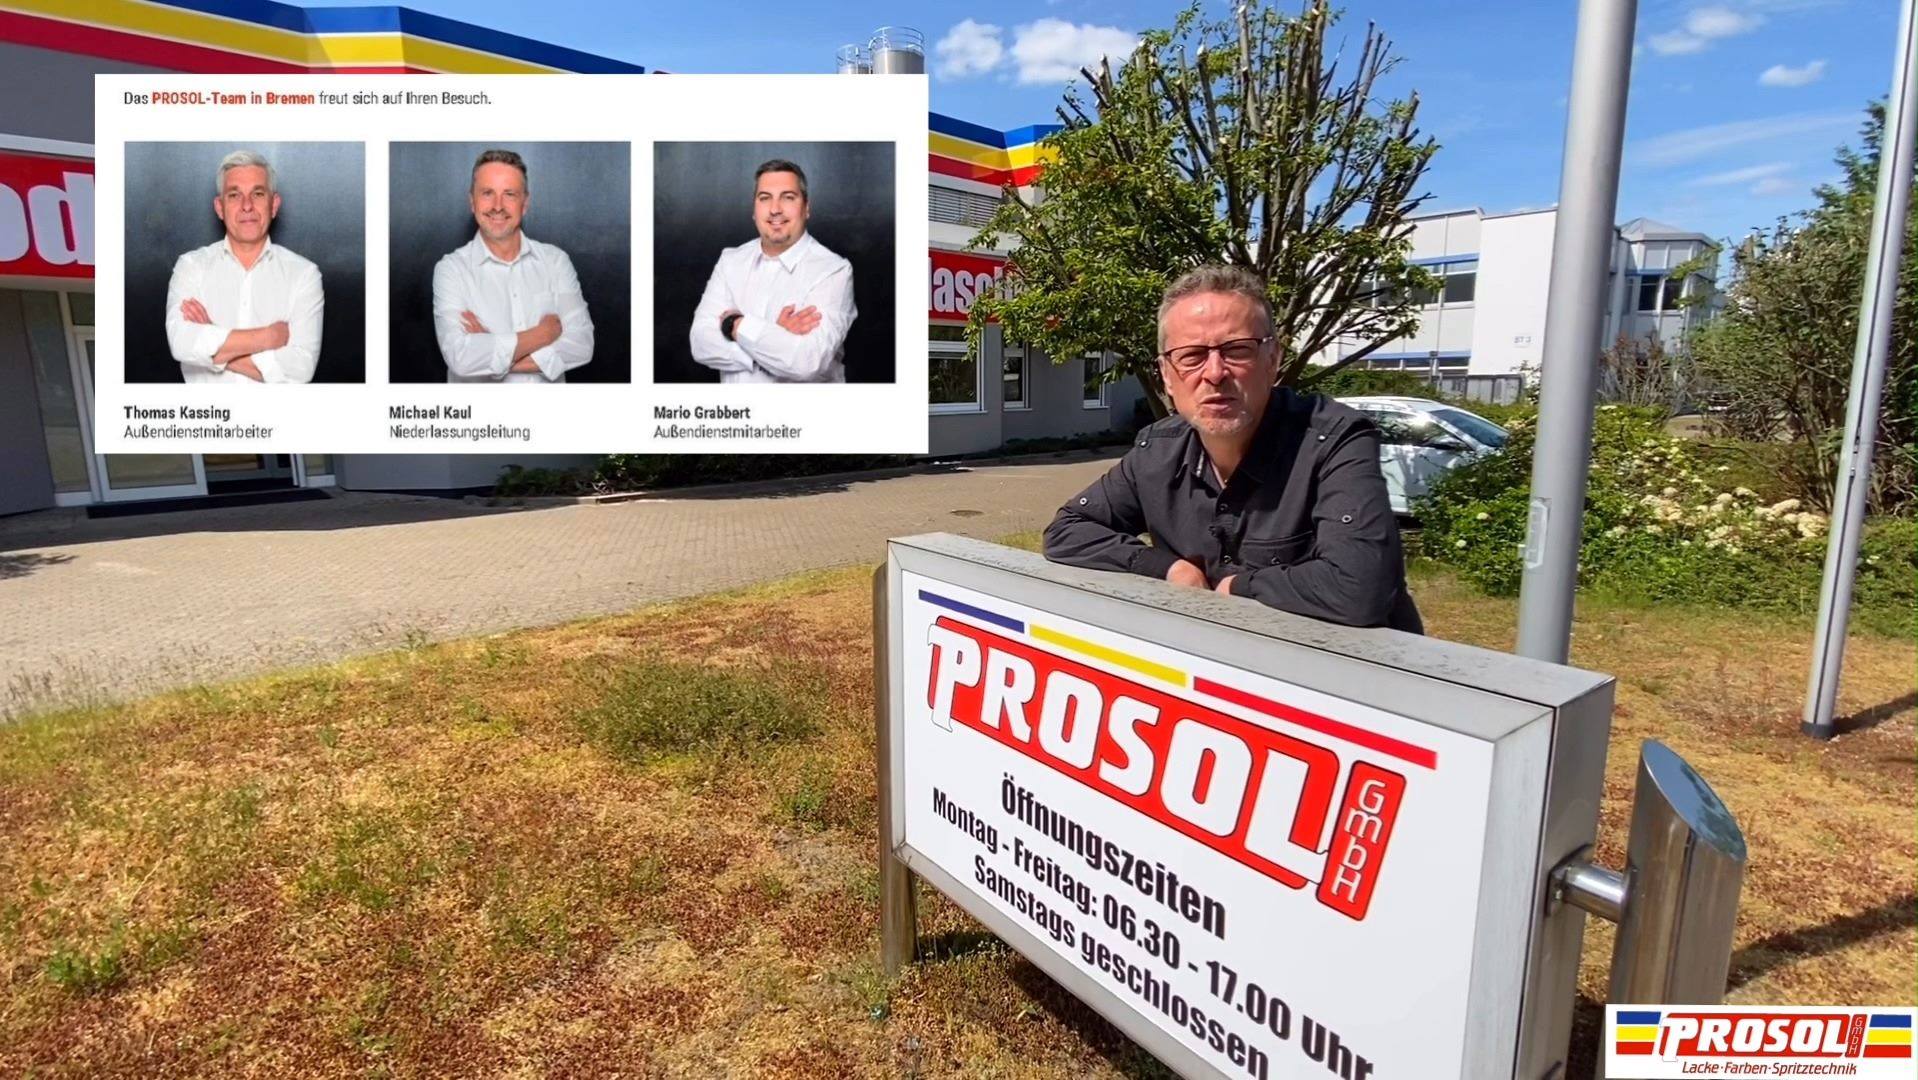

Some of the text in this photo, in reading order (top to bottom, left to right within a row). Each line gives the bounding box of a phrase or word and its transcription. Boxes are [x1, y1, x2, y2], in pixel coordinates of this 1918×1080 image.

[927, 623, 1330, 885] PROSOL
[1001, 771, 1226, 941] Öffnungszeiten
[1331, 779, 1386, 904] GmbH
[932, 786, 998, 855] Montag
[1014, 836, 1097, 917] Freitag:
[1103, 893, 1181, 970] 06.30
[1206, 960, 1291, 1041] 17.00
[1302, 1014, 1374, 1080] Uhr
[974, 854, 1269, 1080] Samstags geschlossen
